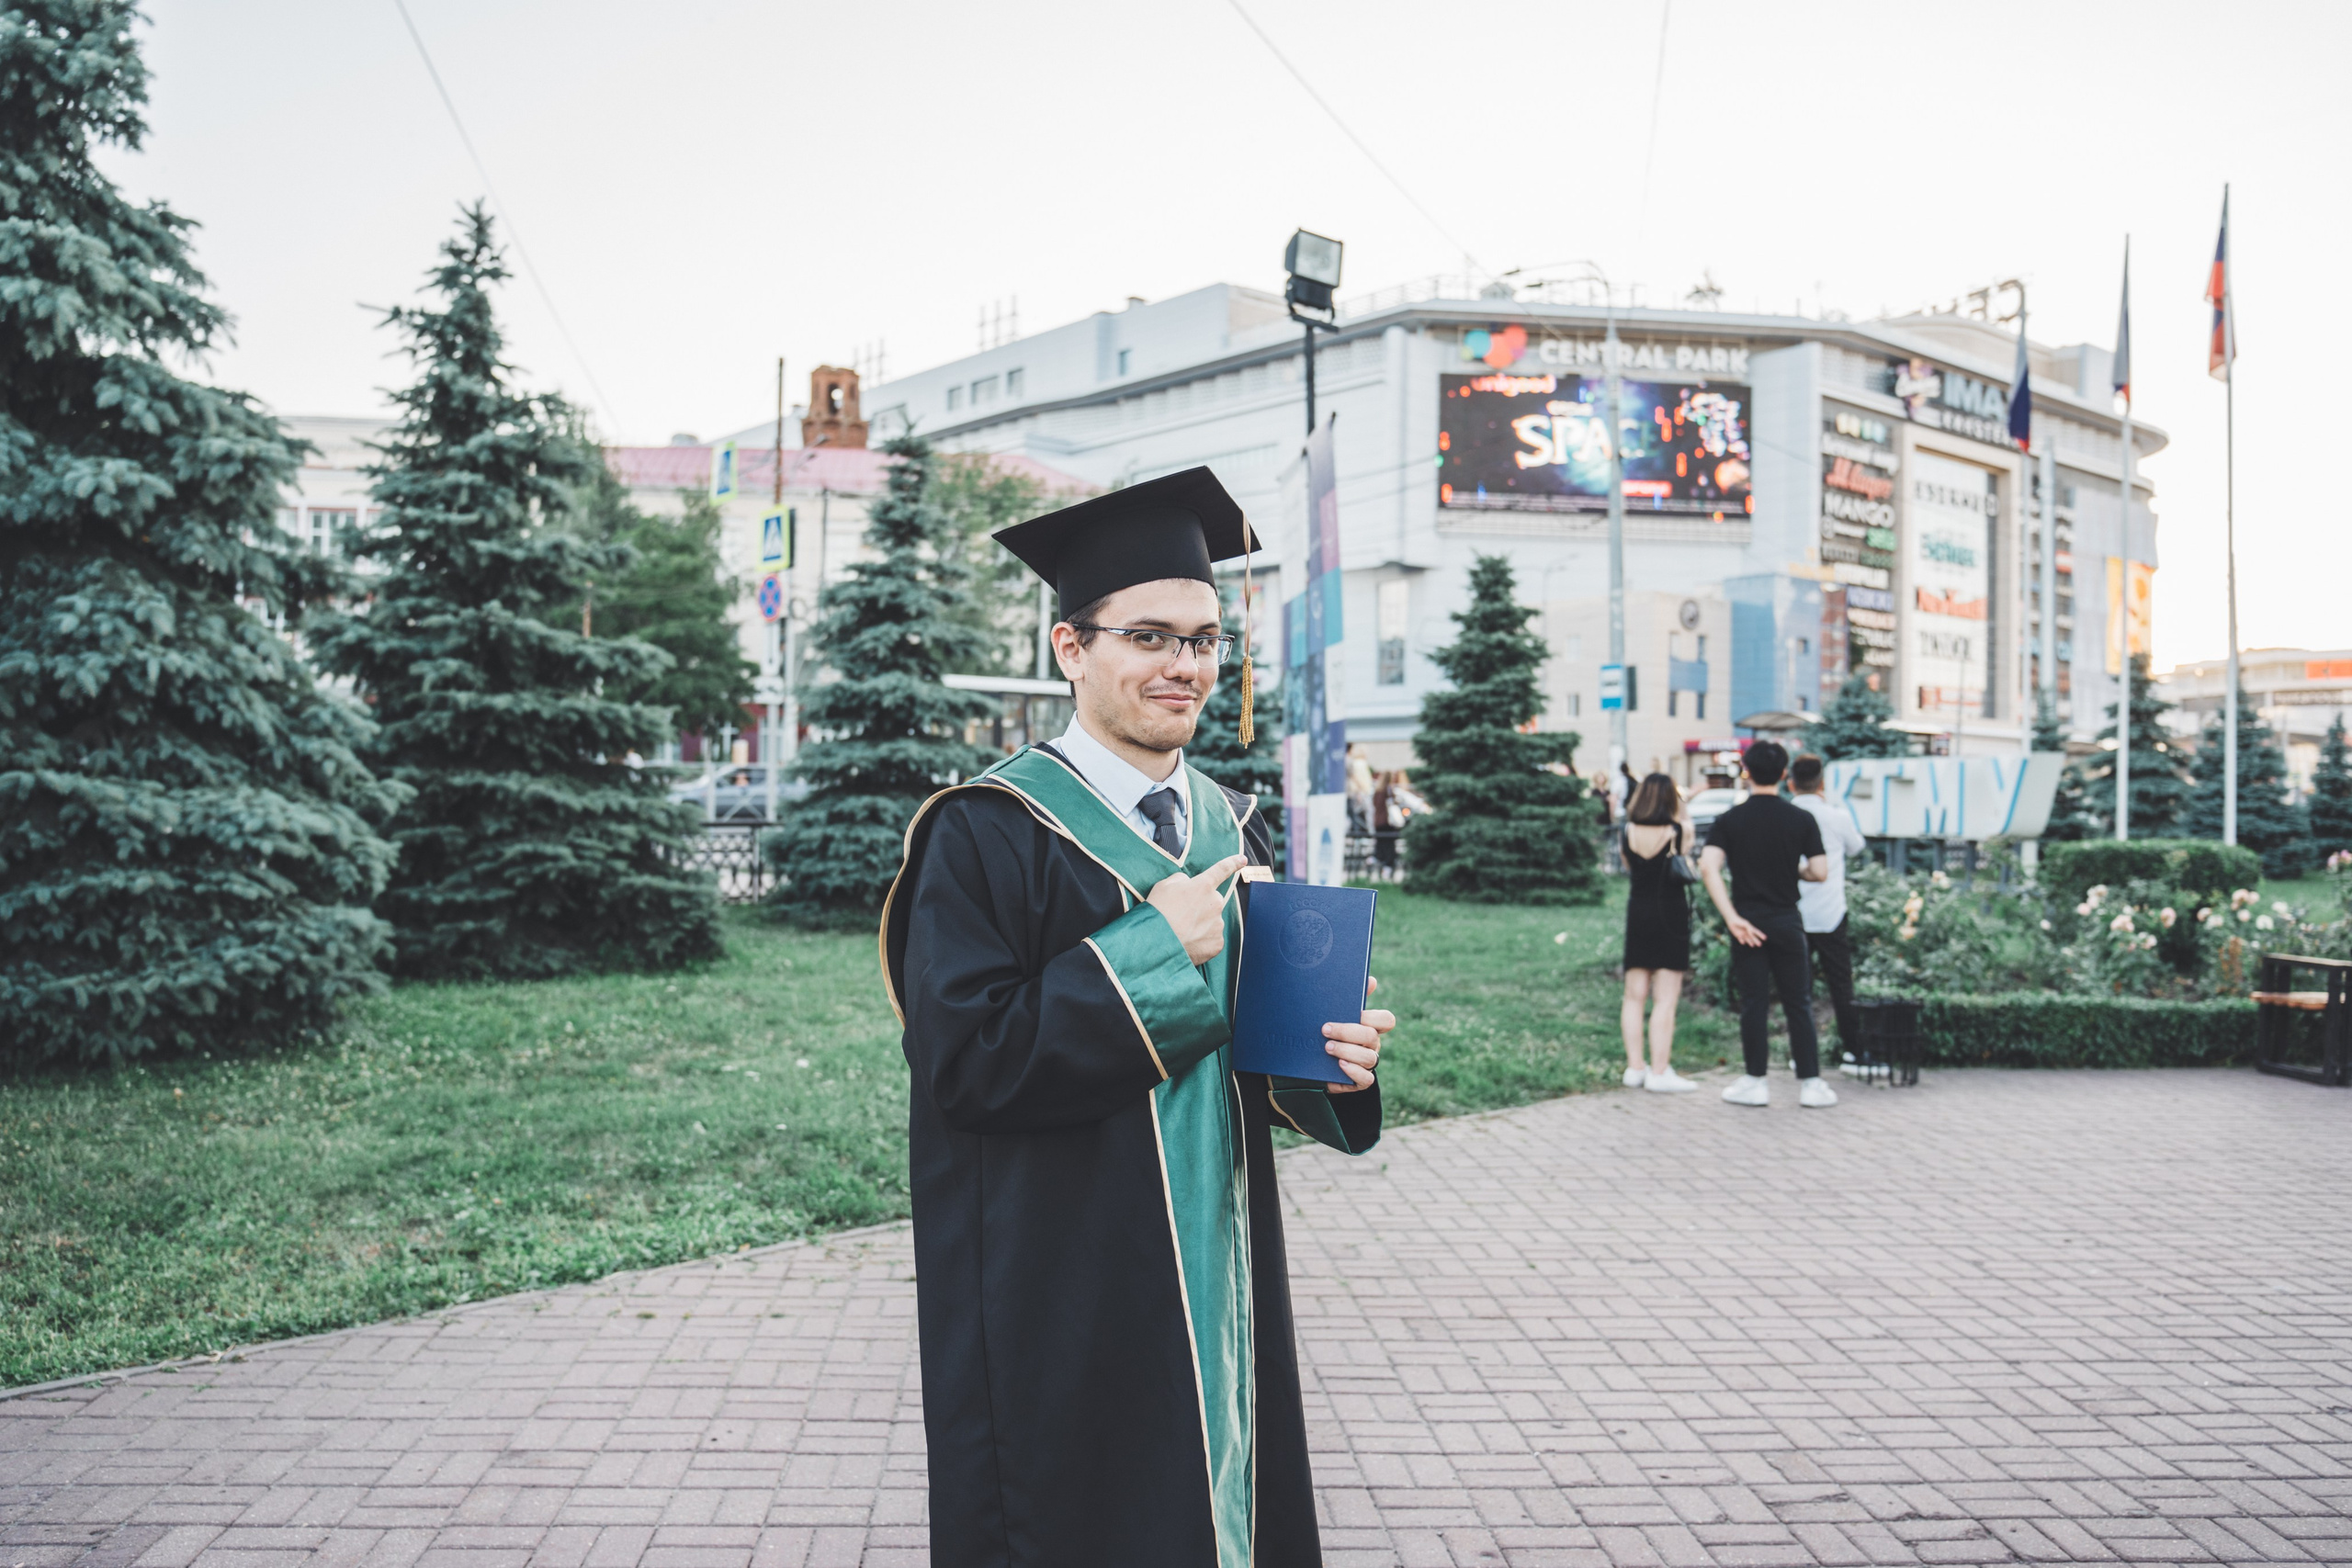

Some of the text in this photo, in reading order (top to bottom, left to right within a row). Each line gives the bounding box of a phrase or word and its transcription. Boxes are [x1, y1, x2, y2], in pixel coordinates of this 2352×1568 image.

[1540, 338, 1750, 374] CENTRAL PARK
[1824, 492, 1896, 528] MANGO
